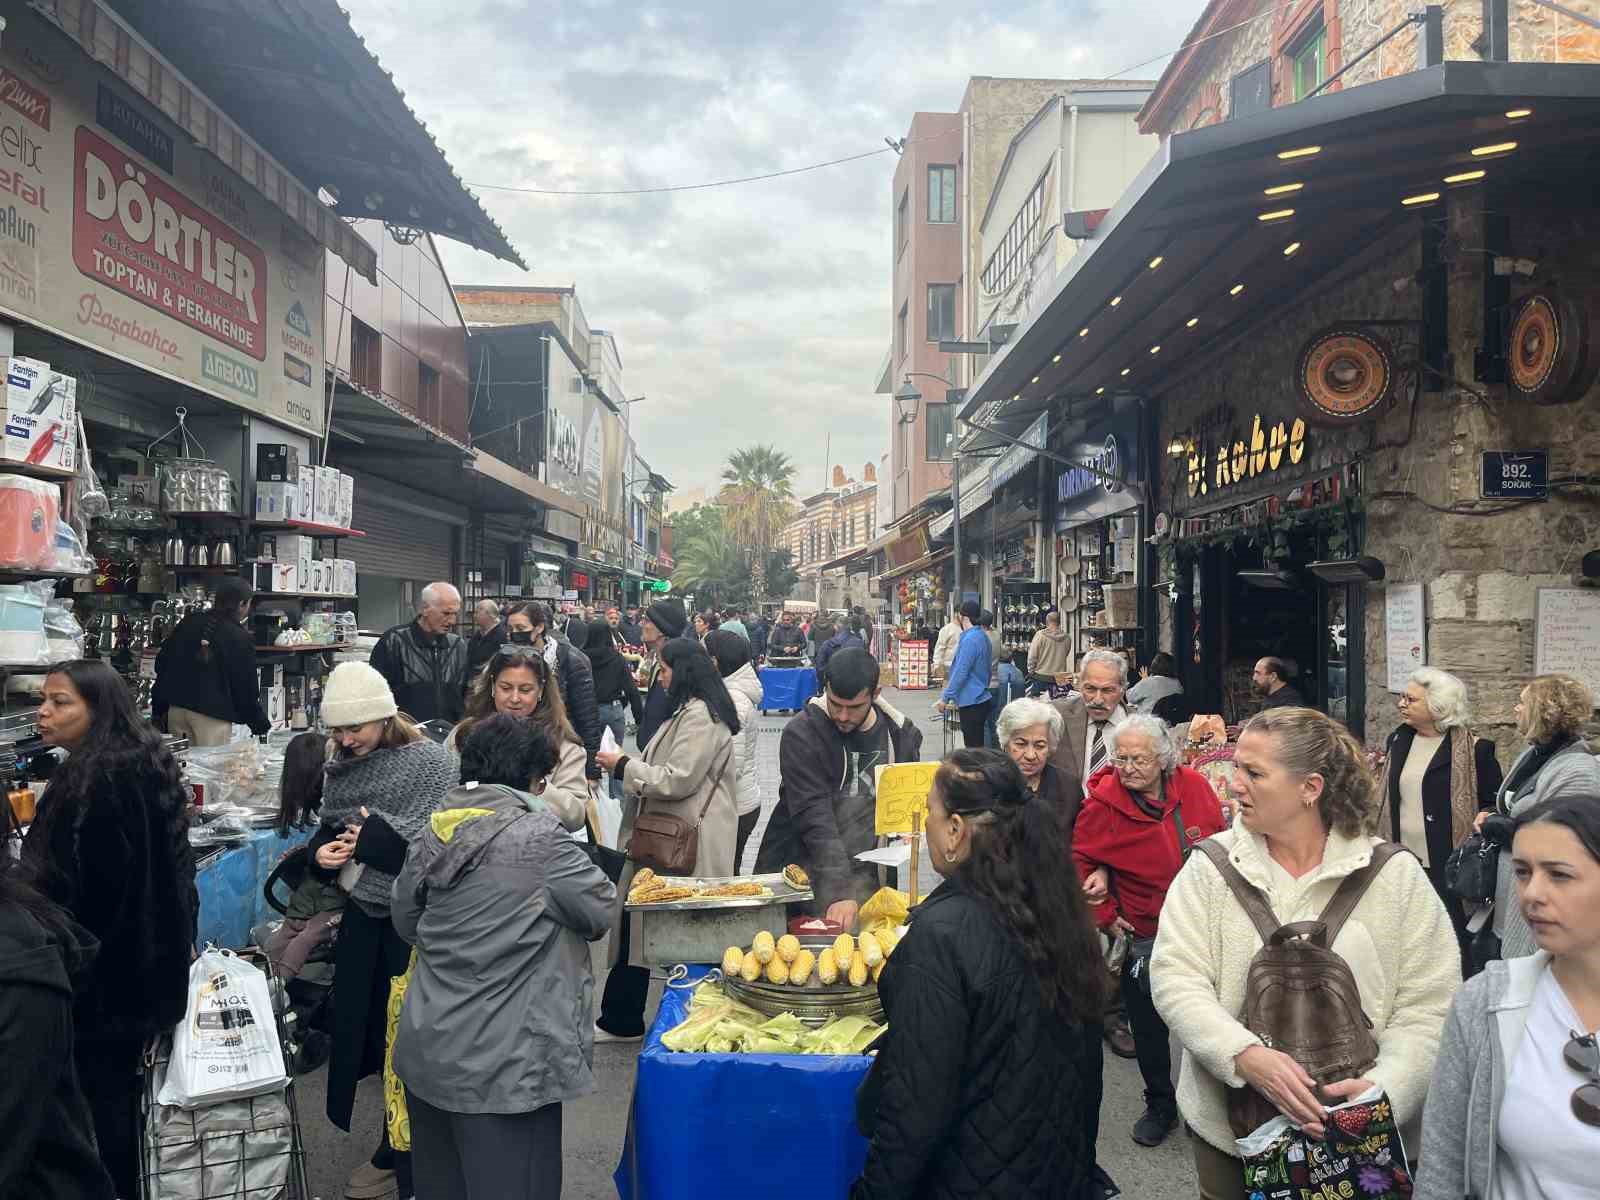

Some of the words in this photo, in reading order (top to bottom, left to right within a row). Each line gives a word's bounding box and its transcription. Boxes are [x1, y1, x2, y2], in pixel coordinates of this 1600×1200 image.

[84, 151, 258, 325] DÖRTLER
[93, 248, 157, 300] TOPTAN
[162, 287, 173, 307] &
[177, 294, 254, 349] PERAKENDE
[77, 291, 183, 362] Paşabahçe
[286, 400, 311, 421] arnica
[1502, 464, 1531, 478] 892.
[1502, 480, 1532, 489] SOKAK
